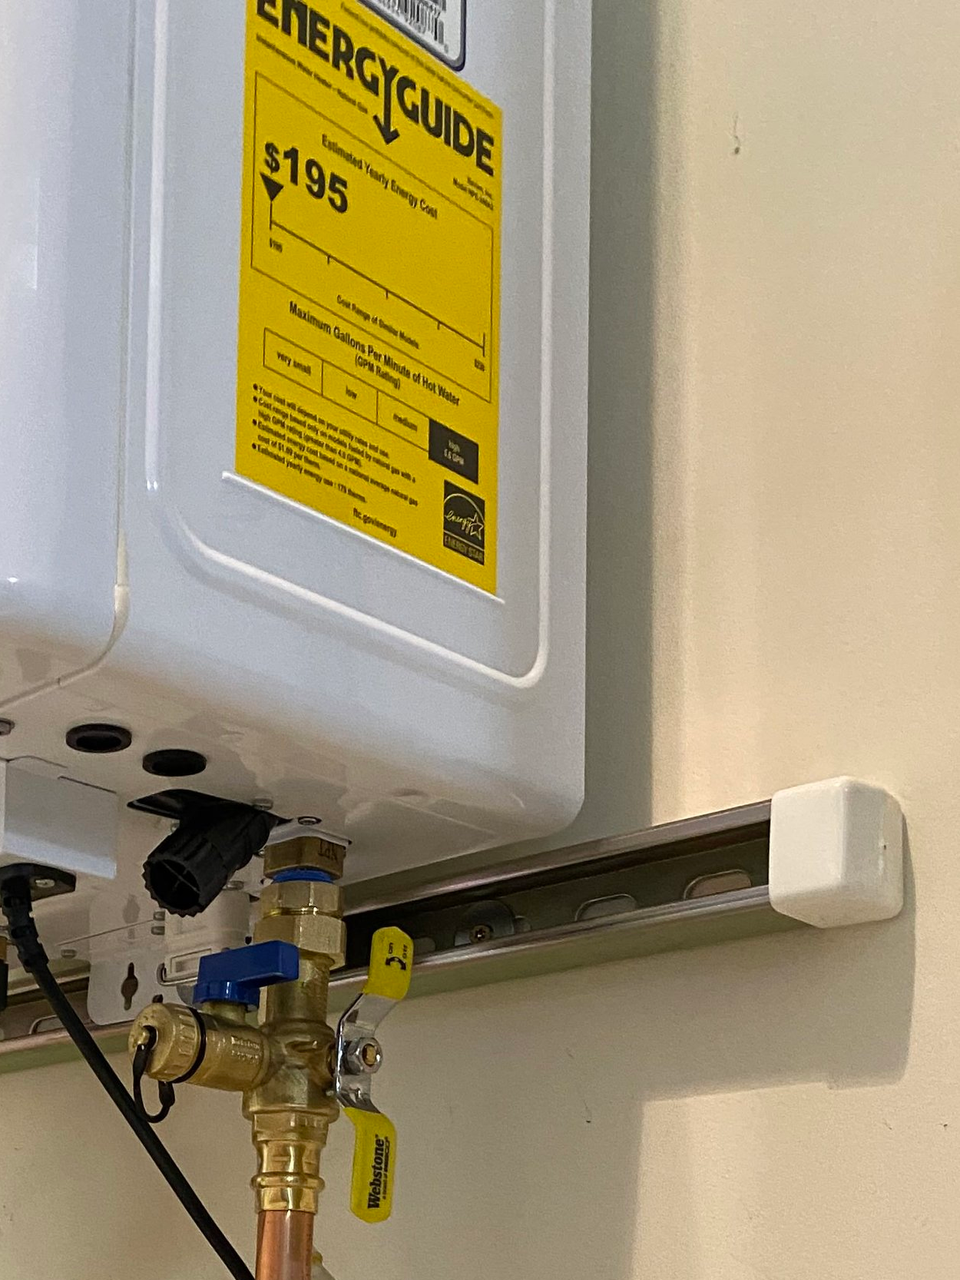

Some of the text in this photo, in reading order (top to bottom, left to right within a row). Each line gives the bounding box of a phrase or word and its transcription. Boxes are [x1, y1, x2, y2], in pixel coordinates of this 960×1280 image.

[264, 142, 348, 214] $195
[322, 134, 438, 220] Estimated Yearly Energy Cost
[289, 300, 461, 406] Maximum Gallons Per Minute of Hot Water
[366, 1137, 385, 1210] Webstone
